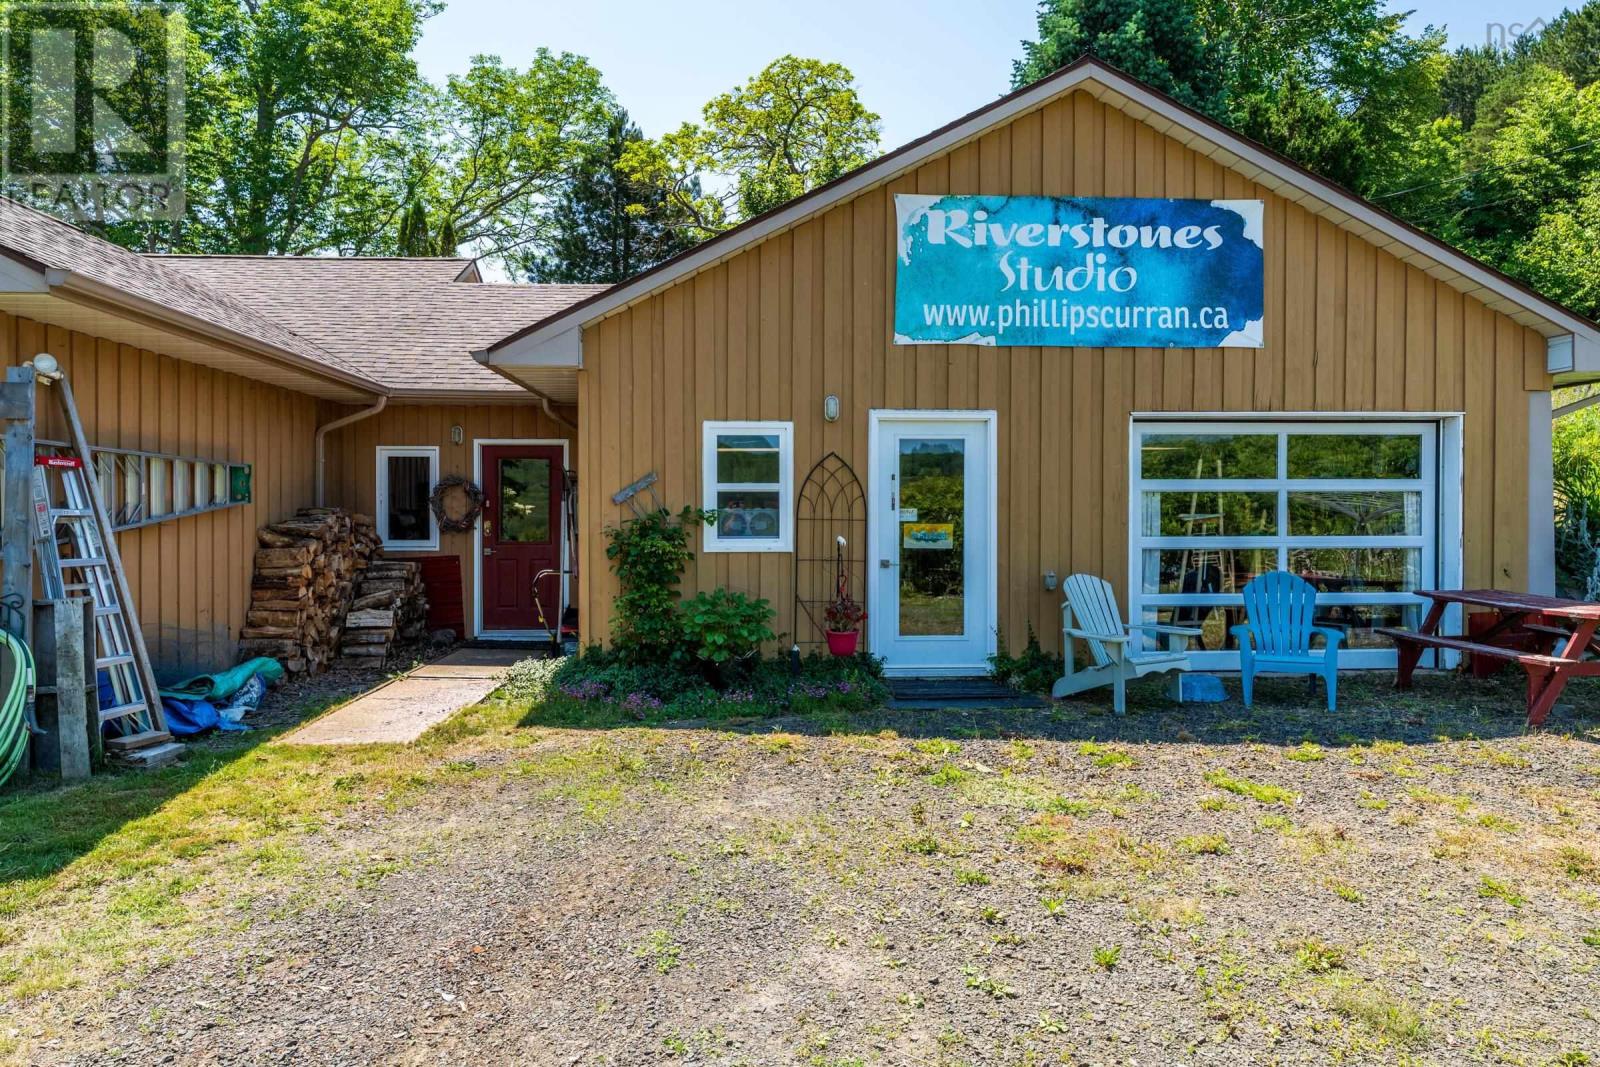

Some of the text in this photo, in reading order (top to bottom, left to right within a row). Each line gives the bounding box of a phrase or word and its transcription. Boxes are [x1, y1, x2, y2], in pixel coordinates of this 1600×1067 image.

[926, 209, 1224, 250] Riverstones
[1000, 250, 1137, 292] Studio
[922, 298, 1229, 335] www.phillipscurran.ca
